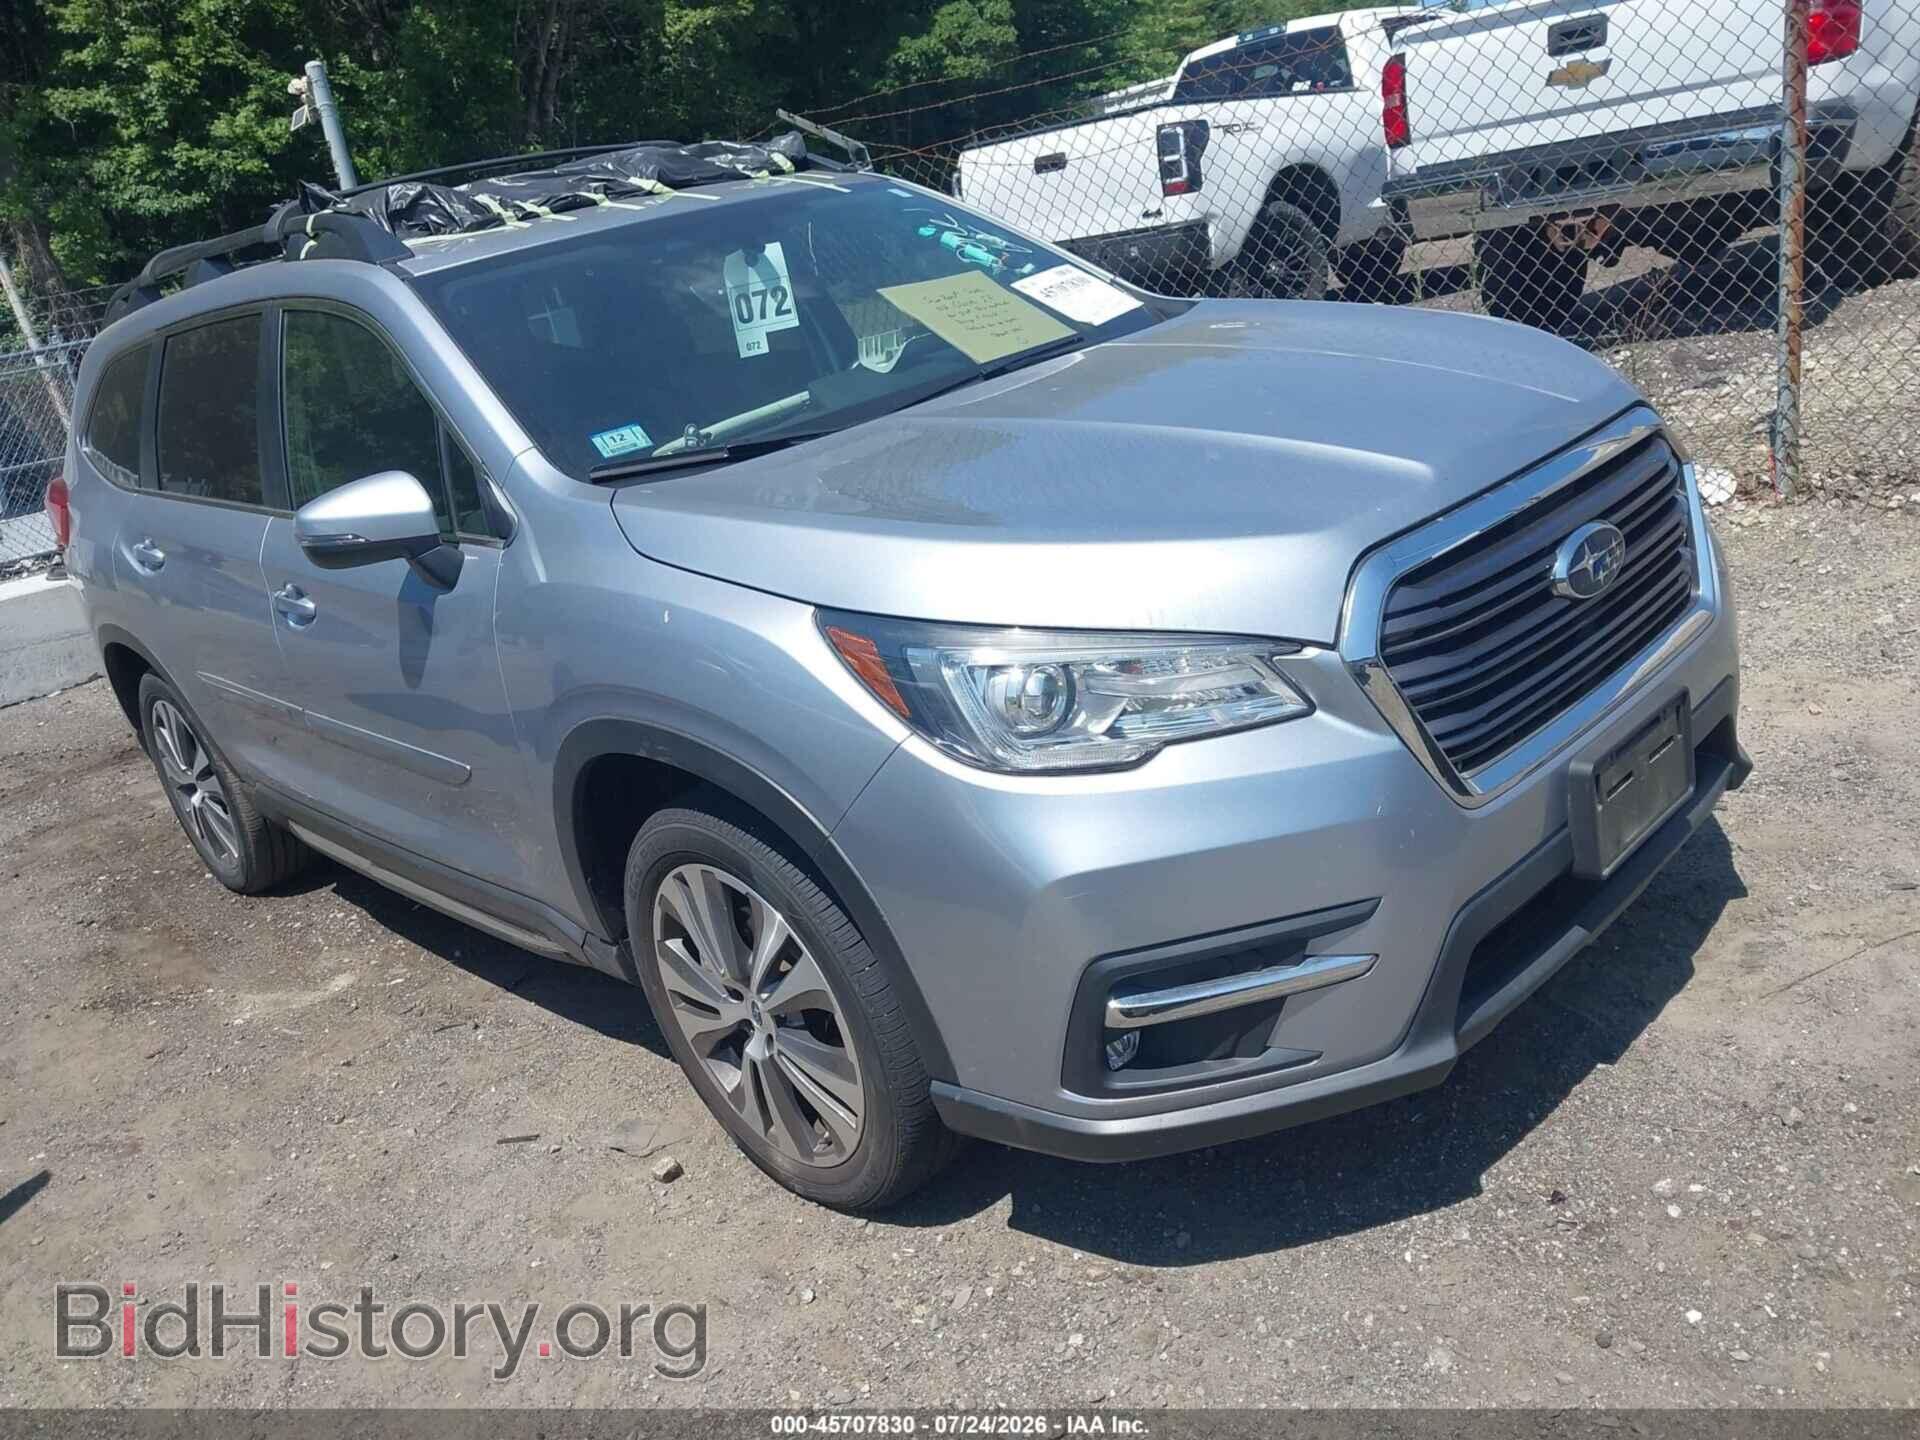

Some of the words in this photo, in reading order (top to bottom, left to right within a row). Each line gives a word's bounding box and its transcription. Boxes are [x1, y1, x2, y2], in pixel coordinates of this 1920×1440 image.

[734, 285, 793, 325] 072
[745, 340, 762, 352] 072
[609, 433, 627, 443] 12
